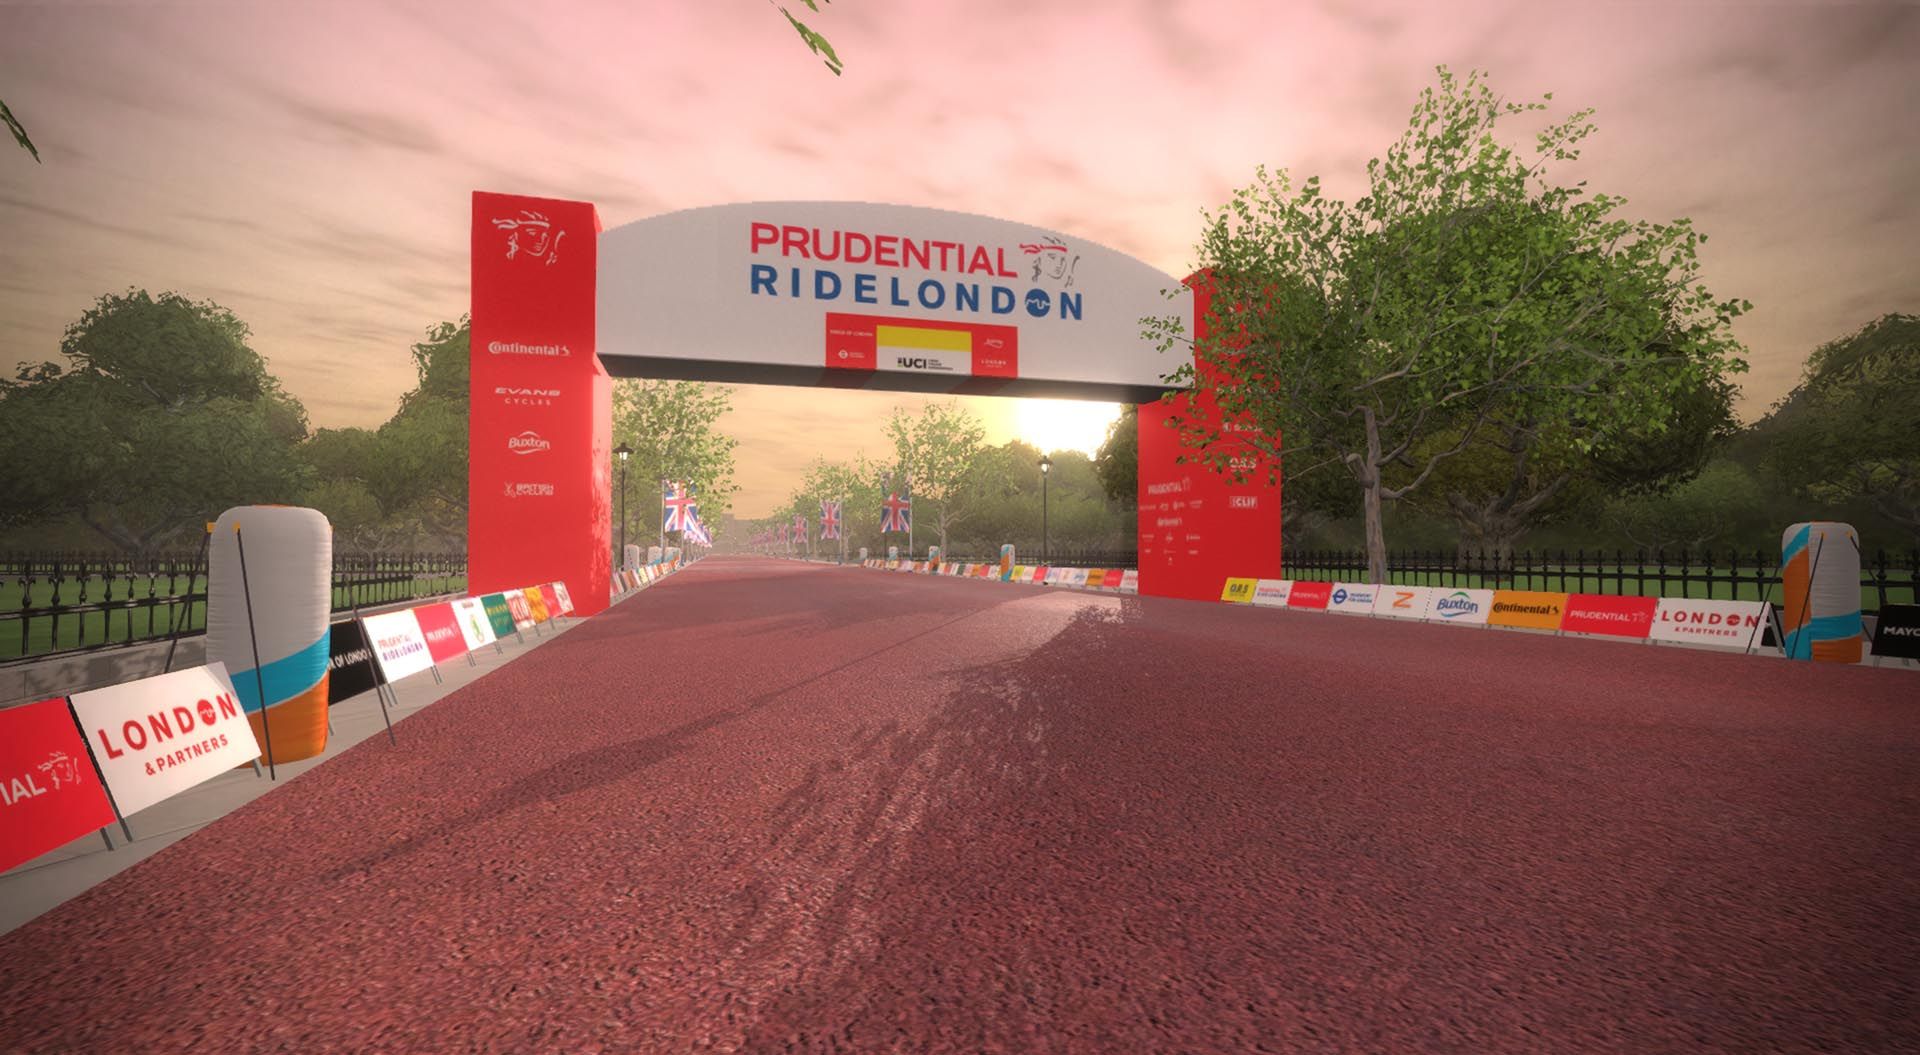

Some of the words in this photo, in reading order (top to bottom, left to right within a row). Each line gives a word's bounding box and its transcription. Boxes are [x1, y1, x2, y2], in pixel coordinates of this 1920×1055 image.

[751, 222, 1018, 279] PRUDENTIAL
[751, 264, 1083, 321] RIDELONDON
[488, 341, 560, 356] Continental
[903, 357, 927, 369] UCI
[495, 387, 561, 396] EVANS
[504, 397, 551, 406] CYCLES
[508, 437, 551, 450] Buxton
[1437, 599, 1478, 614] Buxton
[1493, 602, 1550, 616] Continental
[1570, 610, 1631, 623] PRUDENTIAL
[1661, 610, 1760, 628] LONDON
[1682, 627, 1738, 637] PARTNERS
[98, 692, 238, 760] LONDON
[145, 762, 156, 776] &
[158, 733, 229, 772] PARTNERS
